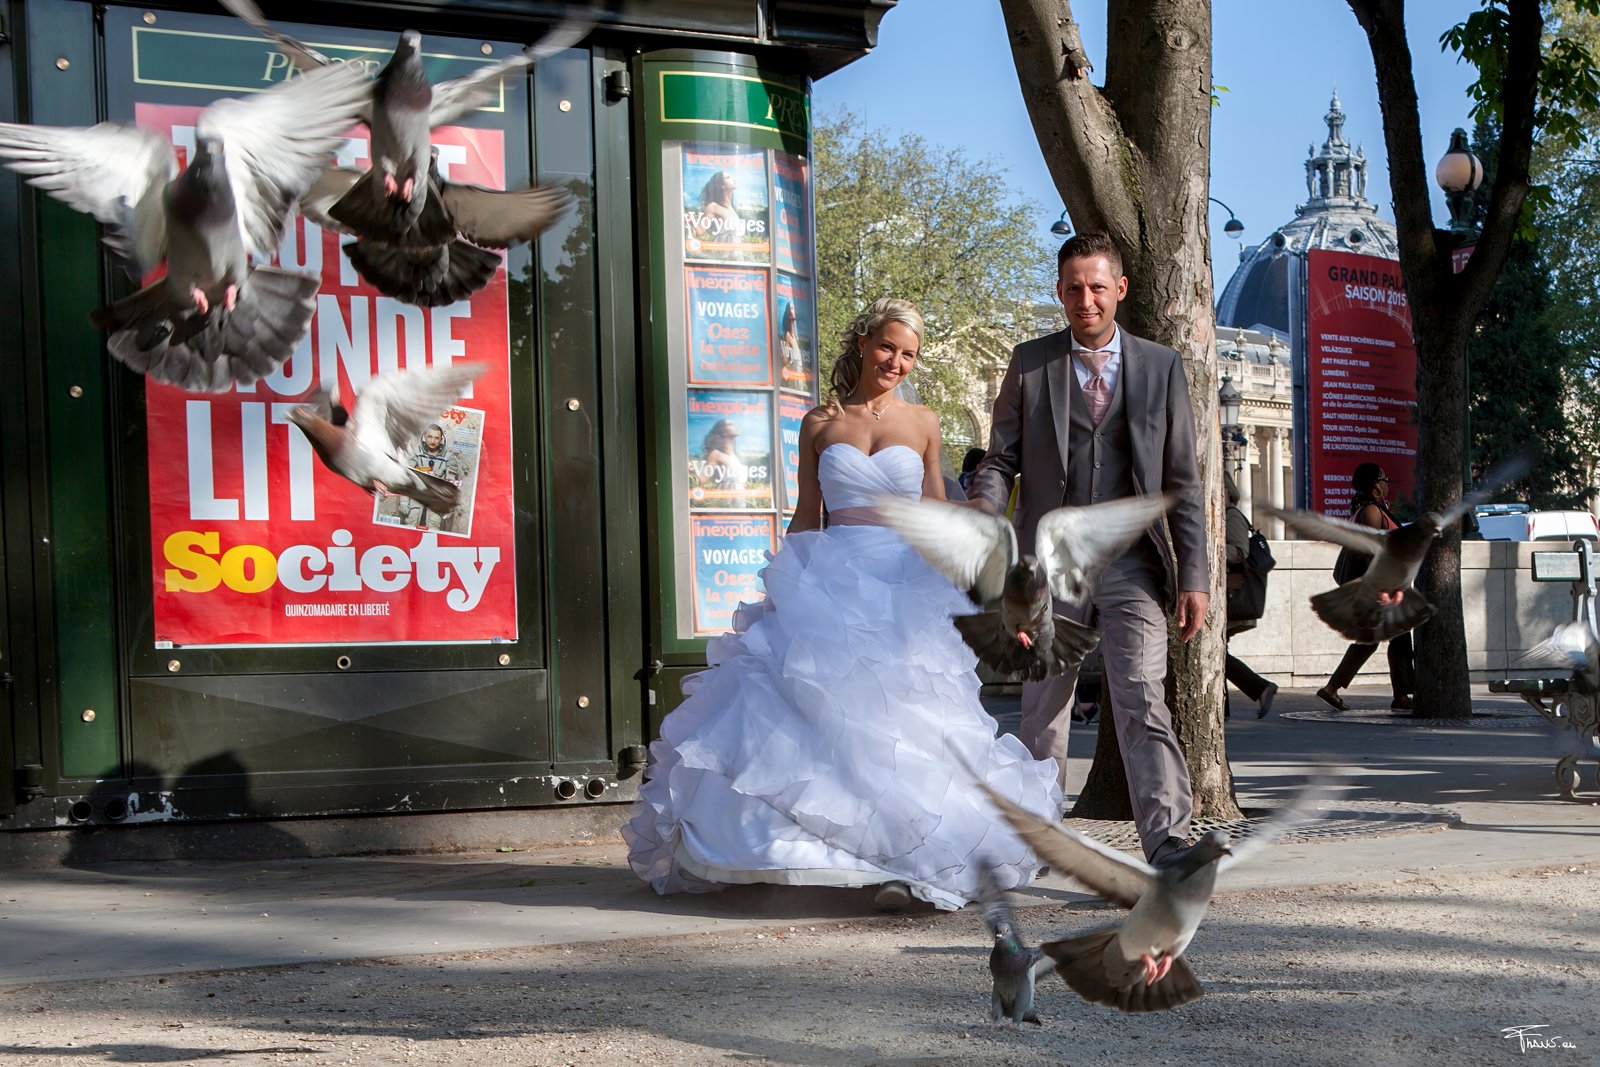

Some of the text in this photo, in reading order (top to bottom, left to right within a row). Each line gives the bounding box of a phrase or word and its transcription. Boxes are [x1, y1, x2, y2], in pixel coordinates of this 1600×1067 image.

[1328, 266, 1378, 287] GRAND
[1345, 284, 1407, 307] SAISON 2015
[697, 301, 759, 319] VOYAGES
[708, 323, 750, 339] Osez
[1321, 333, 1338, 341] VENTE
[701, 339, 714, 354] la
[186, 401, 316, 521] LIT
[703, 549, 765, 565] VOYAGES
[163, 529, 500, 611] Society
[714, 570, 755, 586] Osez
[706, 587, 719, 602] la
[285, 601, 390, 617] QUINZOMADAIRE EN LIBERTÉ
